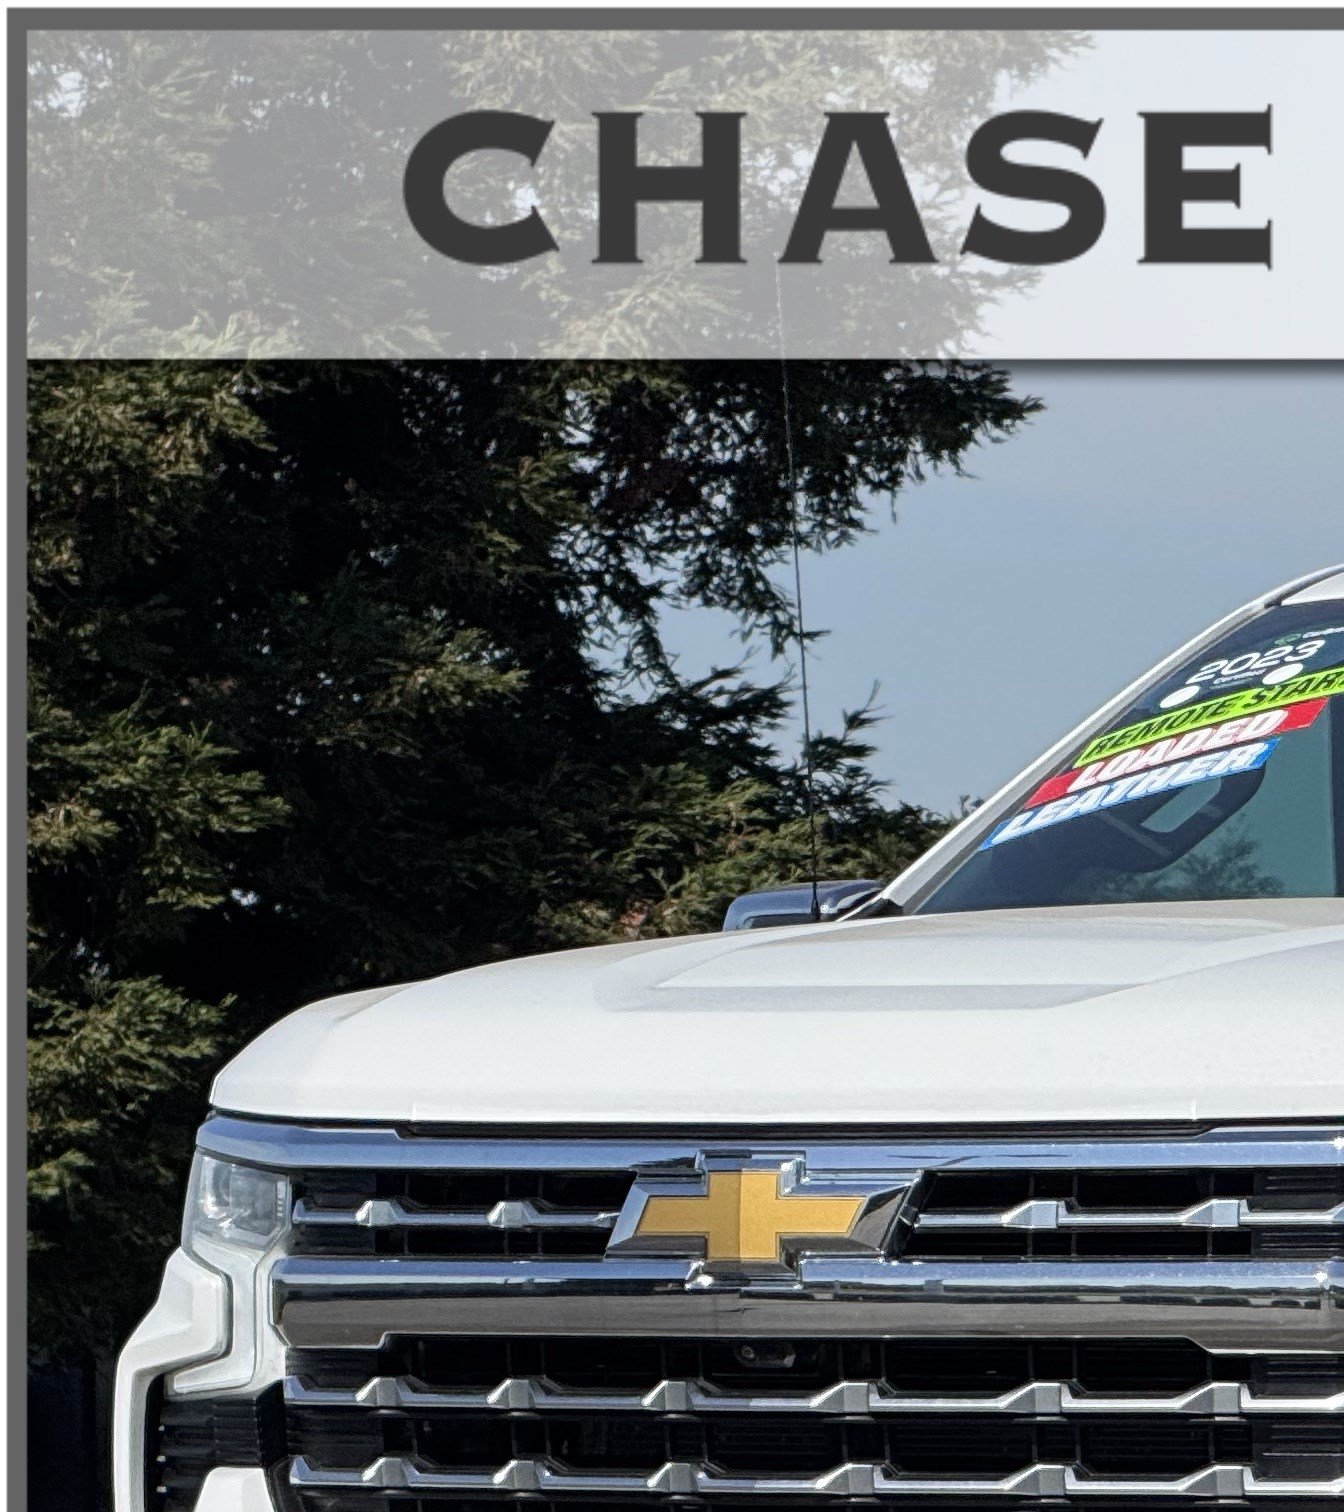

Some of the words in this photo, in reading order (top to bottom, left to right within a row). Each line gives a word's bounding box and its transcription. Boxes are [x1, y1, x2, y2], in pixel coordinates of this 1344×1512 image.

[1185, 639, 1326, 685] 2023
[1066, 708, 1290, 794] LOADED
[1092, 695, 1245, 760] REMOTE
[993, 740, 1270, 845] LEATHER
